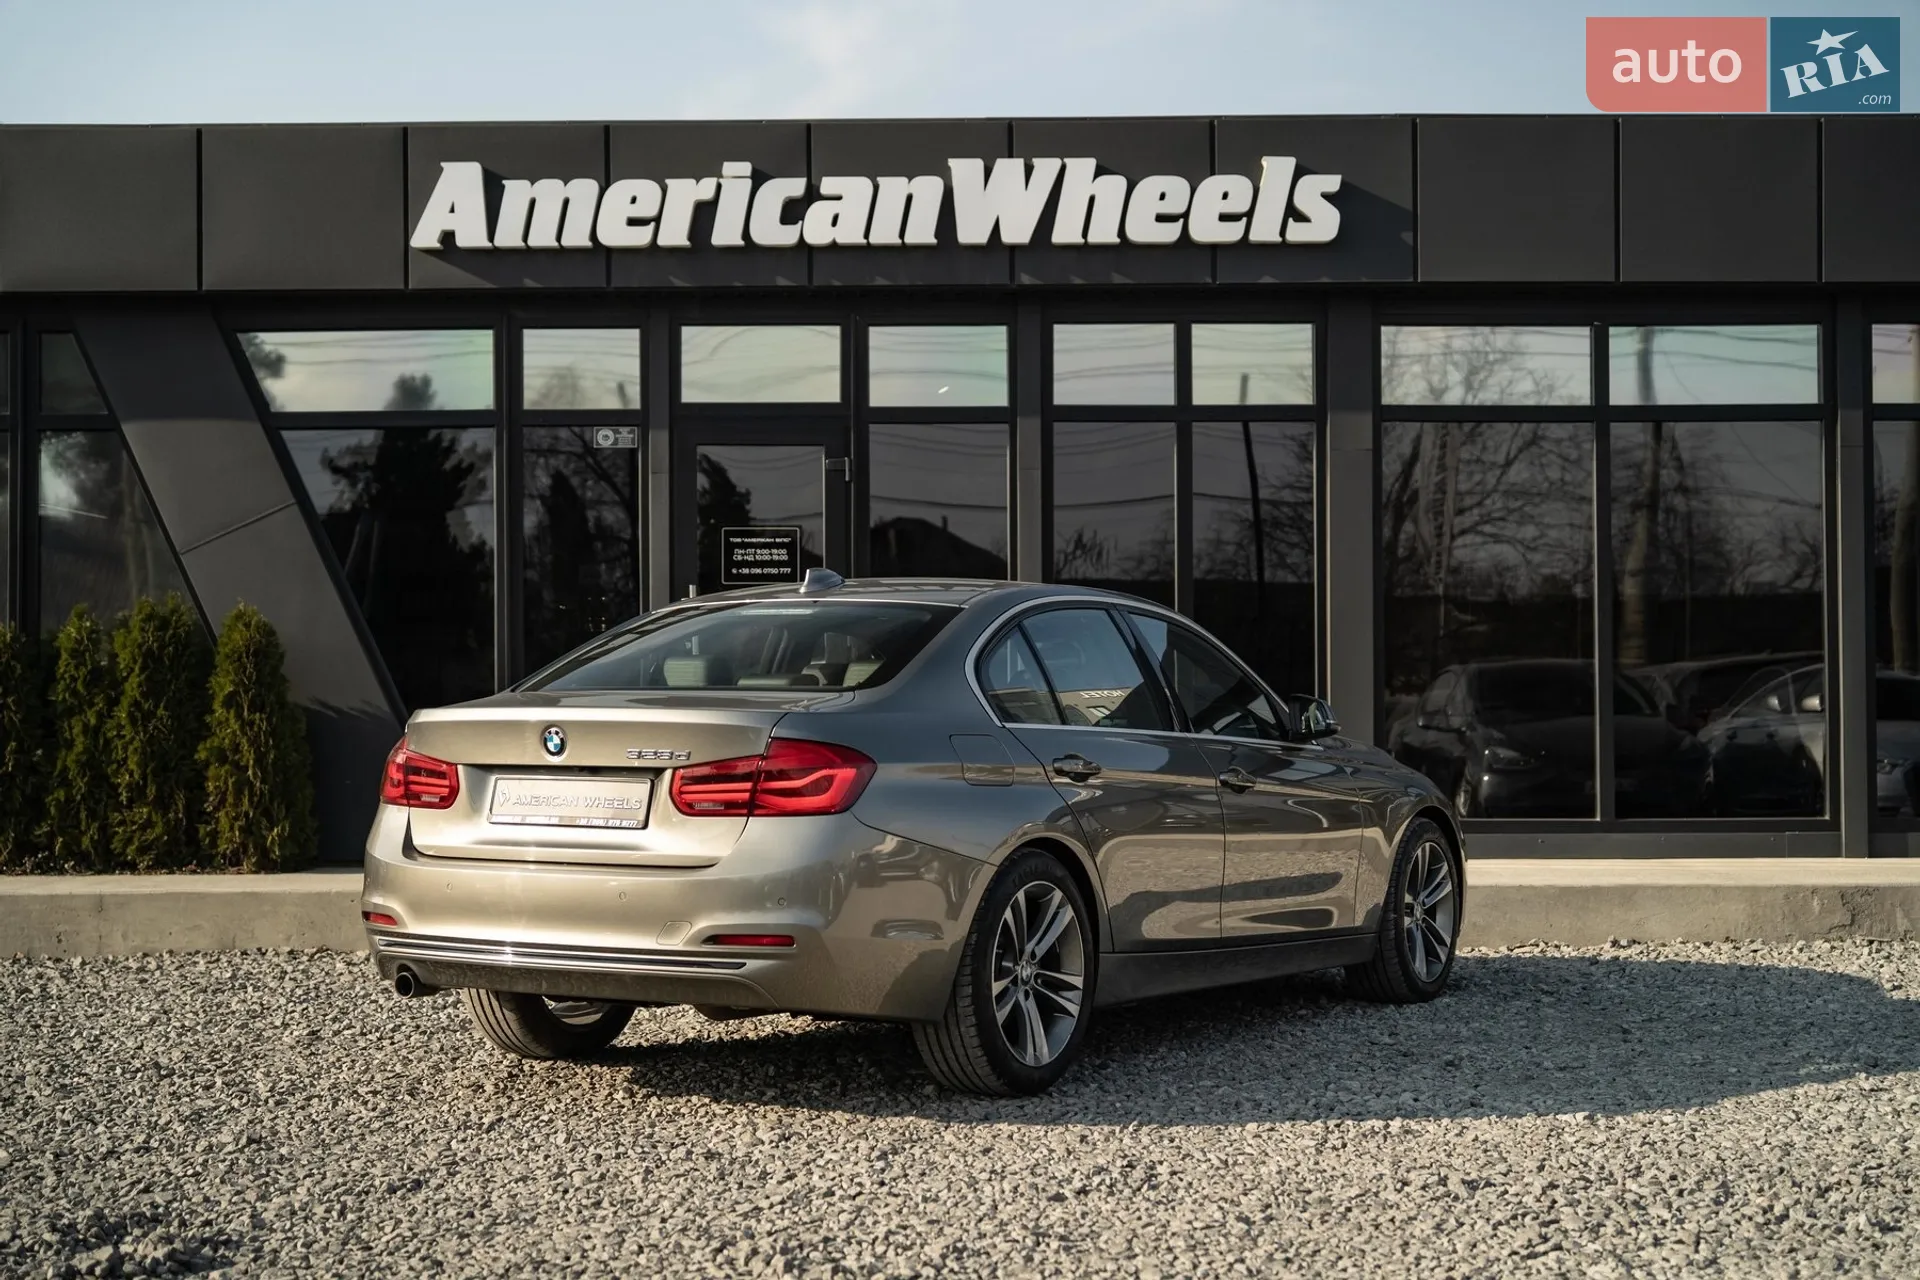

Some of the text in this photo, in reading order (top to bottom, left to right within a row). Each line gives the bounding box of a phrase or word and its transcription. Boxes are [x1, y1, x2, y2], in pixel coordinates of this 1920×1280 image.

[410, 156, 1343, 250] AmericanWheels
[513, 793, 642, 810] AMERICAN WHEELS
